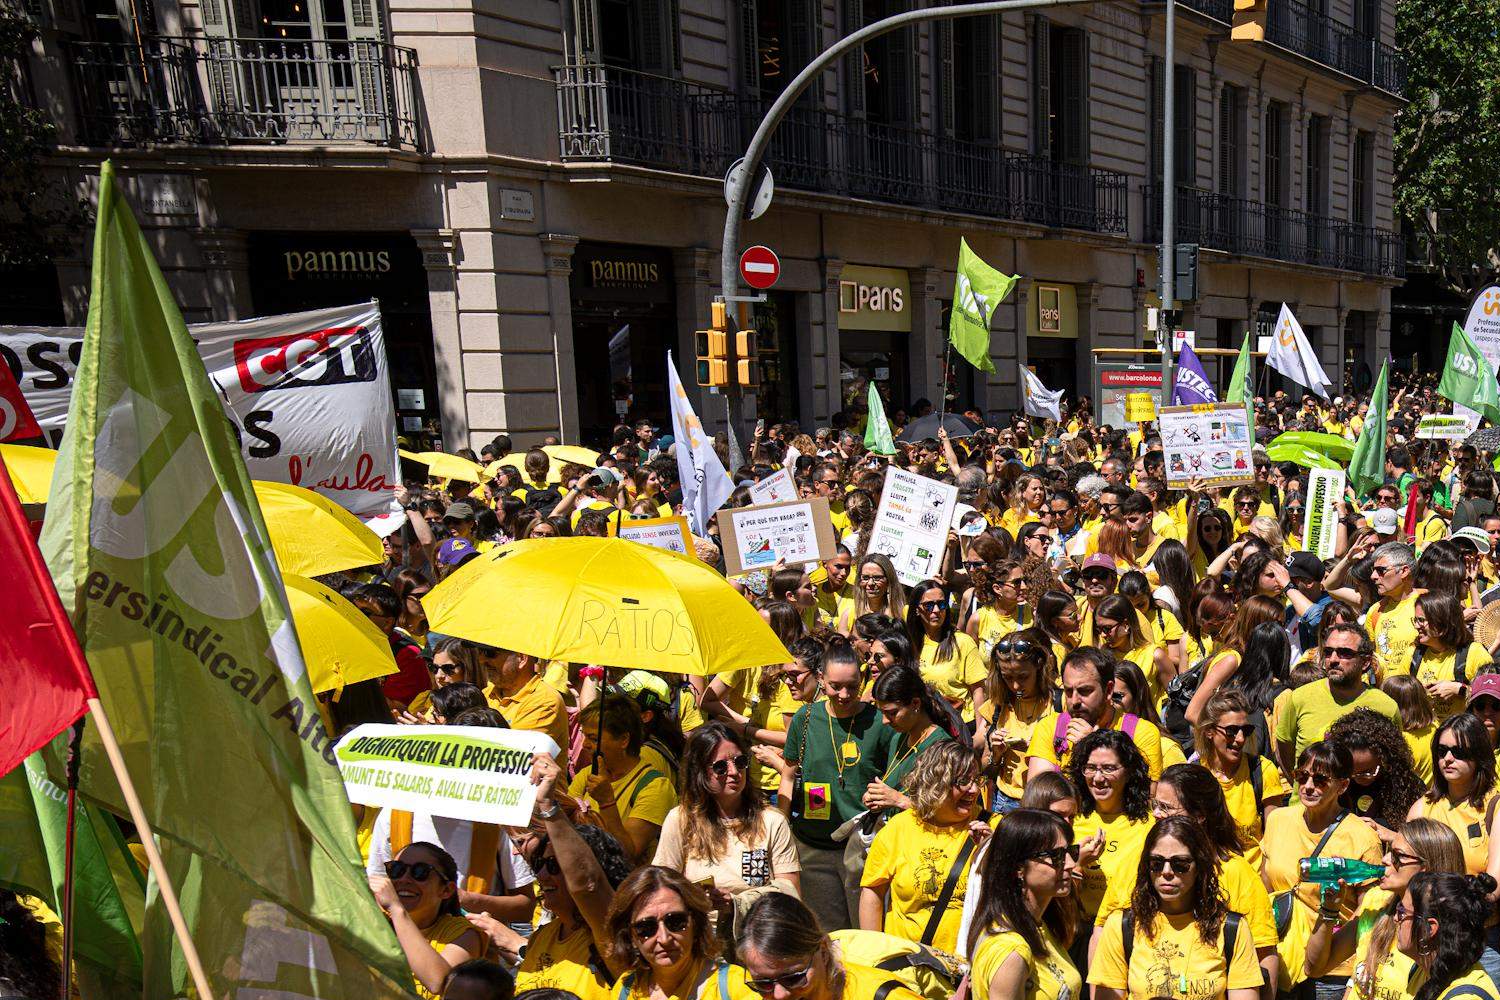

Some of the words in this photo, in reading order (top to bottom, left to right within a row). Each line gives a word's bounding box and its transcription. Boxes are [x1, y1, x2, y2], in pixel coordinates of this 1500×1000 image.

[284, 249, 392, 280] pannus
[591, 258, 659, 282] pannus
[247, 333, 371, 388] CGT
[890, 491, 907, 502] LLUITA
[349, 736, 441, 767] DIGNIFIQUEM
[440, 742, 460, 768] LA
[341, 764, 375, 785] AMUNT
[375, 770, 392, 789] ELS
[392, 773, 434, 799] SALARIS,
[435, 778, 467, 801] AVALL
[467, 782, 486, 802] LES
